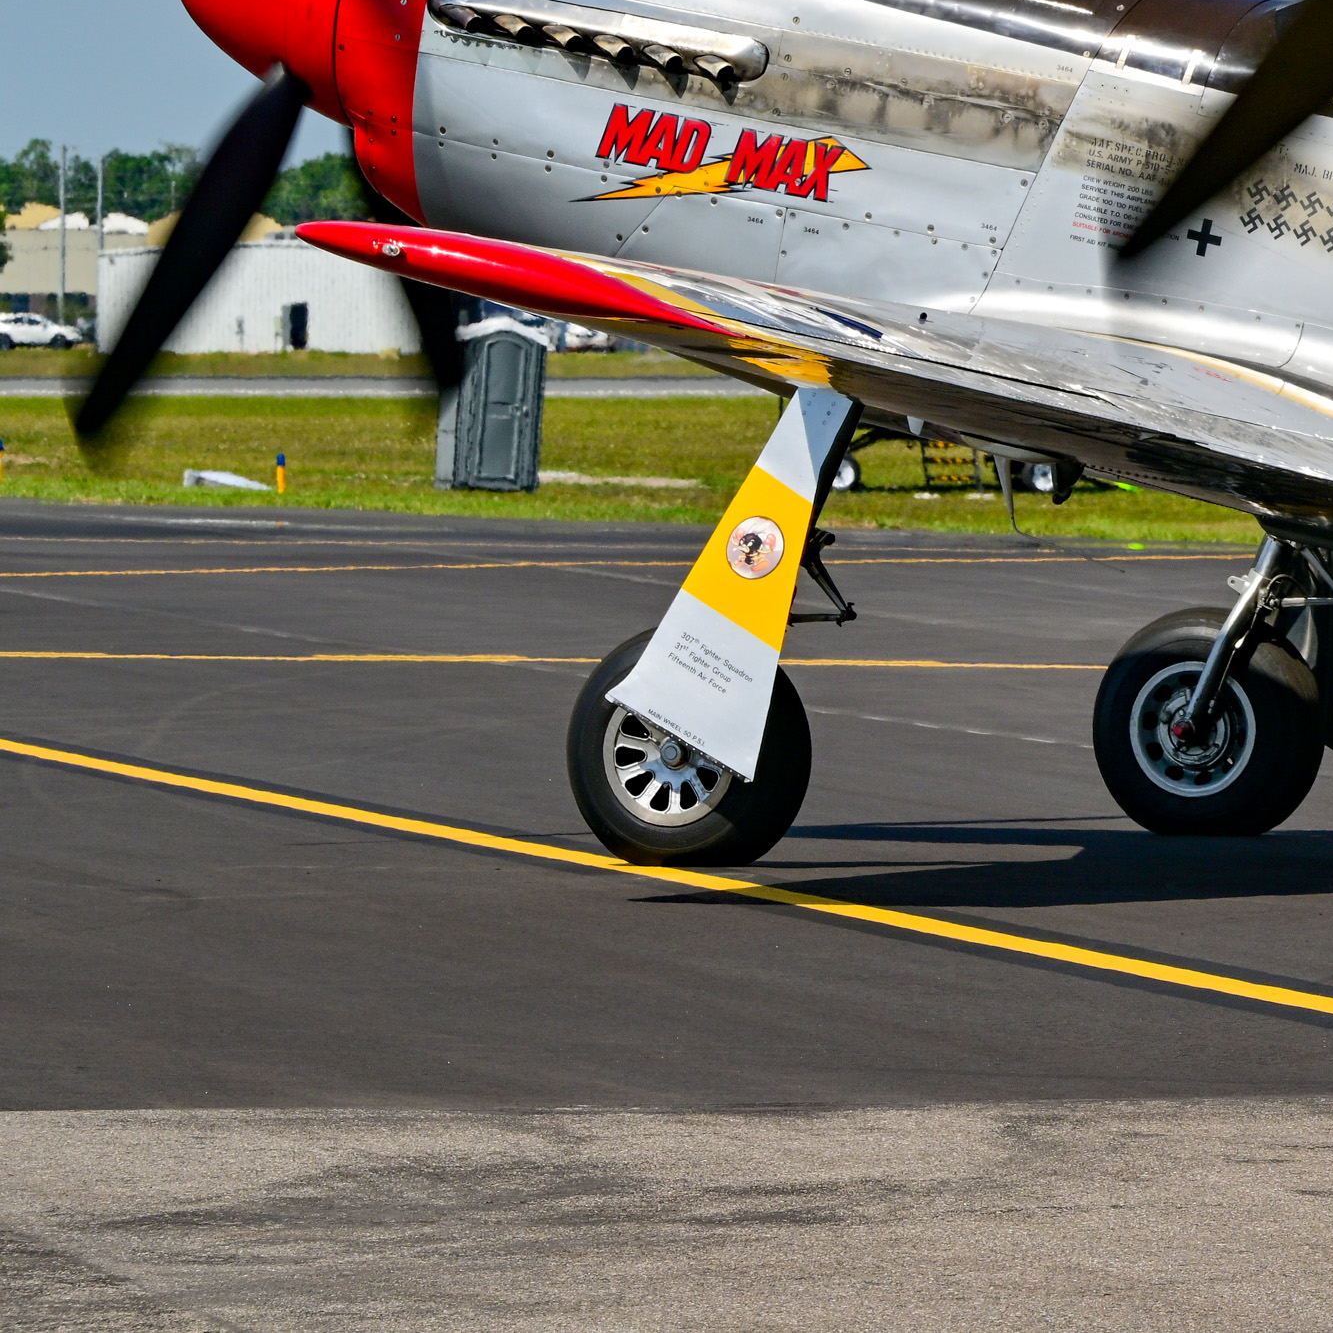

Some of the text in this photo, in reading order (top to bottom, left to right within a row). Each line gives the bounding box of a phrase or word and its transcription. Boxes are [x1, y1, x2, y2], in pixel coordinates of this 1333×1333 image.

[1056, 64, 1073, 73] 3464
[596, 103, 847, 202] MAD MAX
[1088, 149, 1104, 159] U.S.
[1107, 152, 1134, 165] ARMY
[1086, 159, 1115, 174] SERIAL
[1118, 167, 1135, 178] NO.
[1138, 171, 1157, 182] AAF
[1082, 175, 1101, 184] CREW
[1102, 179, 1126, 190] WEIGHT
[1127, 185, 1140, 193] 200
[1079, 192, 1100, 203] GRADE
[1102, 197, 1127, 210] 100/130
[1081, 183, 1156, 206] SERVICE THIS AIRPLAN
[1077, 202, 1108, 215] AVAILABLE
[747, 216, 764, 225] 3464
[980, 222, 998, 232] 3464
[1072, 221, 1097, 232] SUITABLE
[1099, 227, 1111, 235] FOR
[1074, 211, 1108, 225] CONSULTED
[1109, 219, 1122, 228] FOR
[803, 226, 820, 235] 3464
[1069, 234, 1085, 243] FIRST
[674, 641, 732, 683] 31st Fighter Group
[681, 631, 753, 683] 307th Fighter Squadron
[667, 652, 727, 694] Fifteenth Air Force
[647, 708, 663, 721] MAIN
[663, 718, 682, 732] WHEEL
[683, 729, 691, 738] 50
